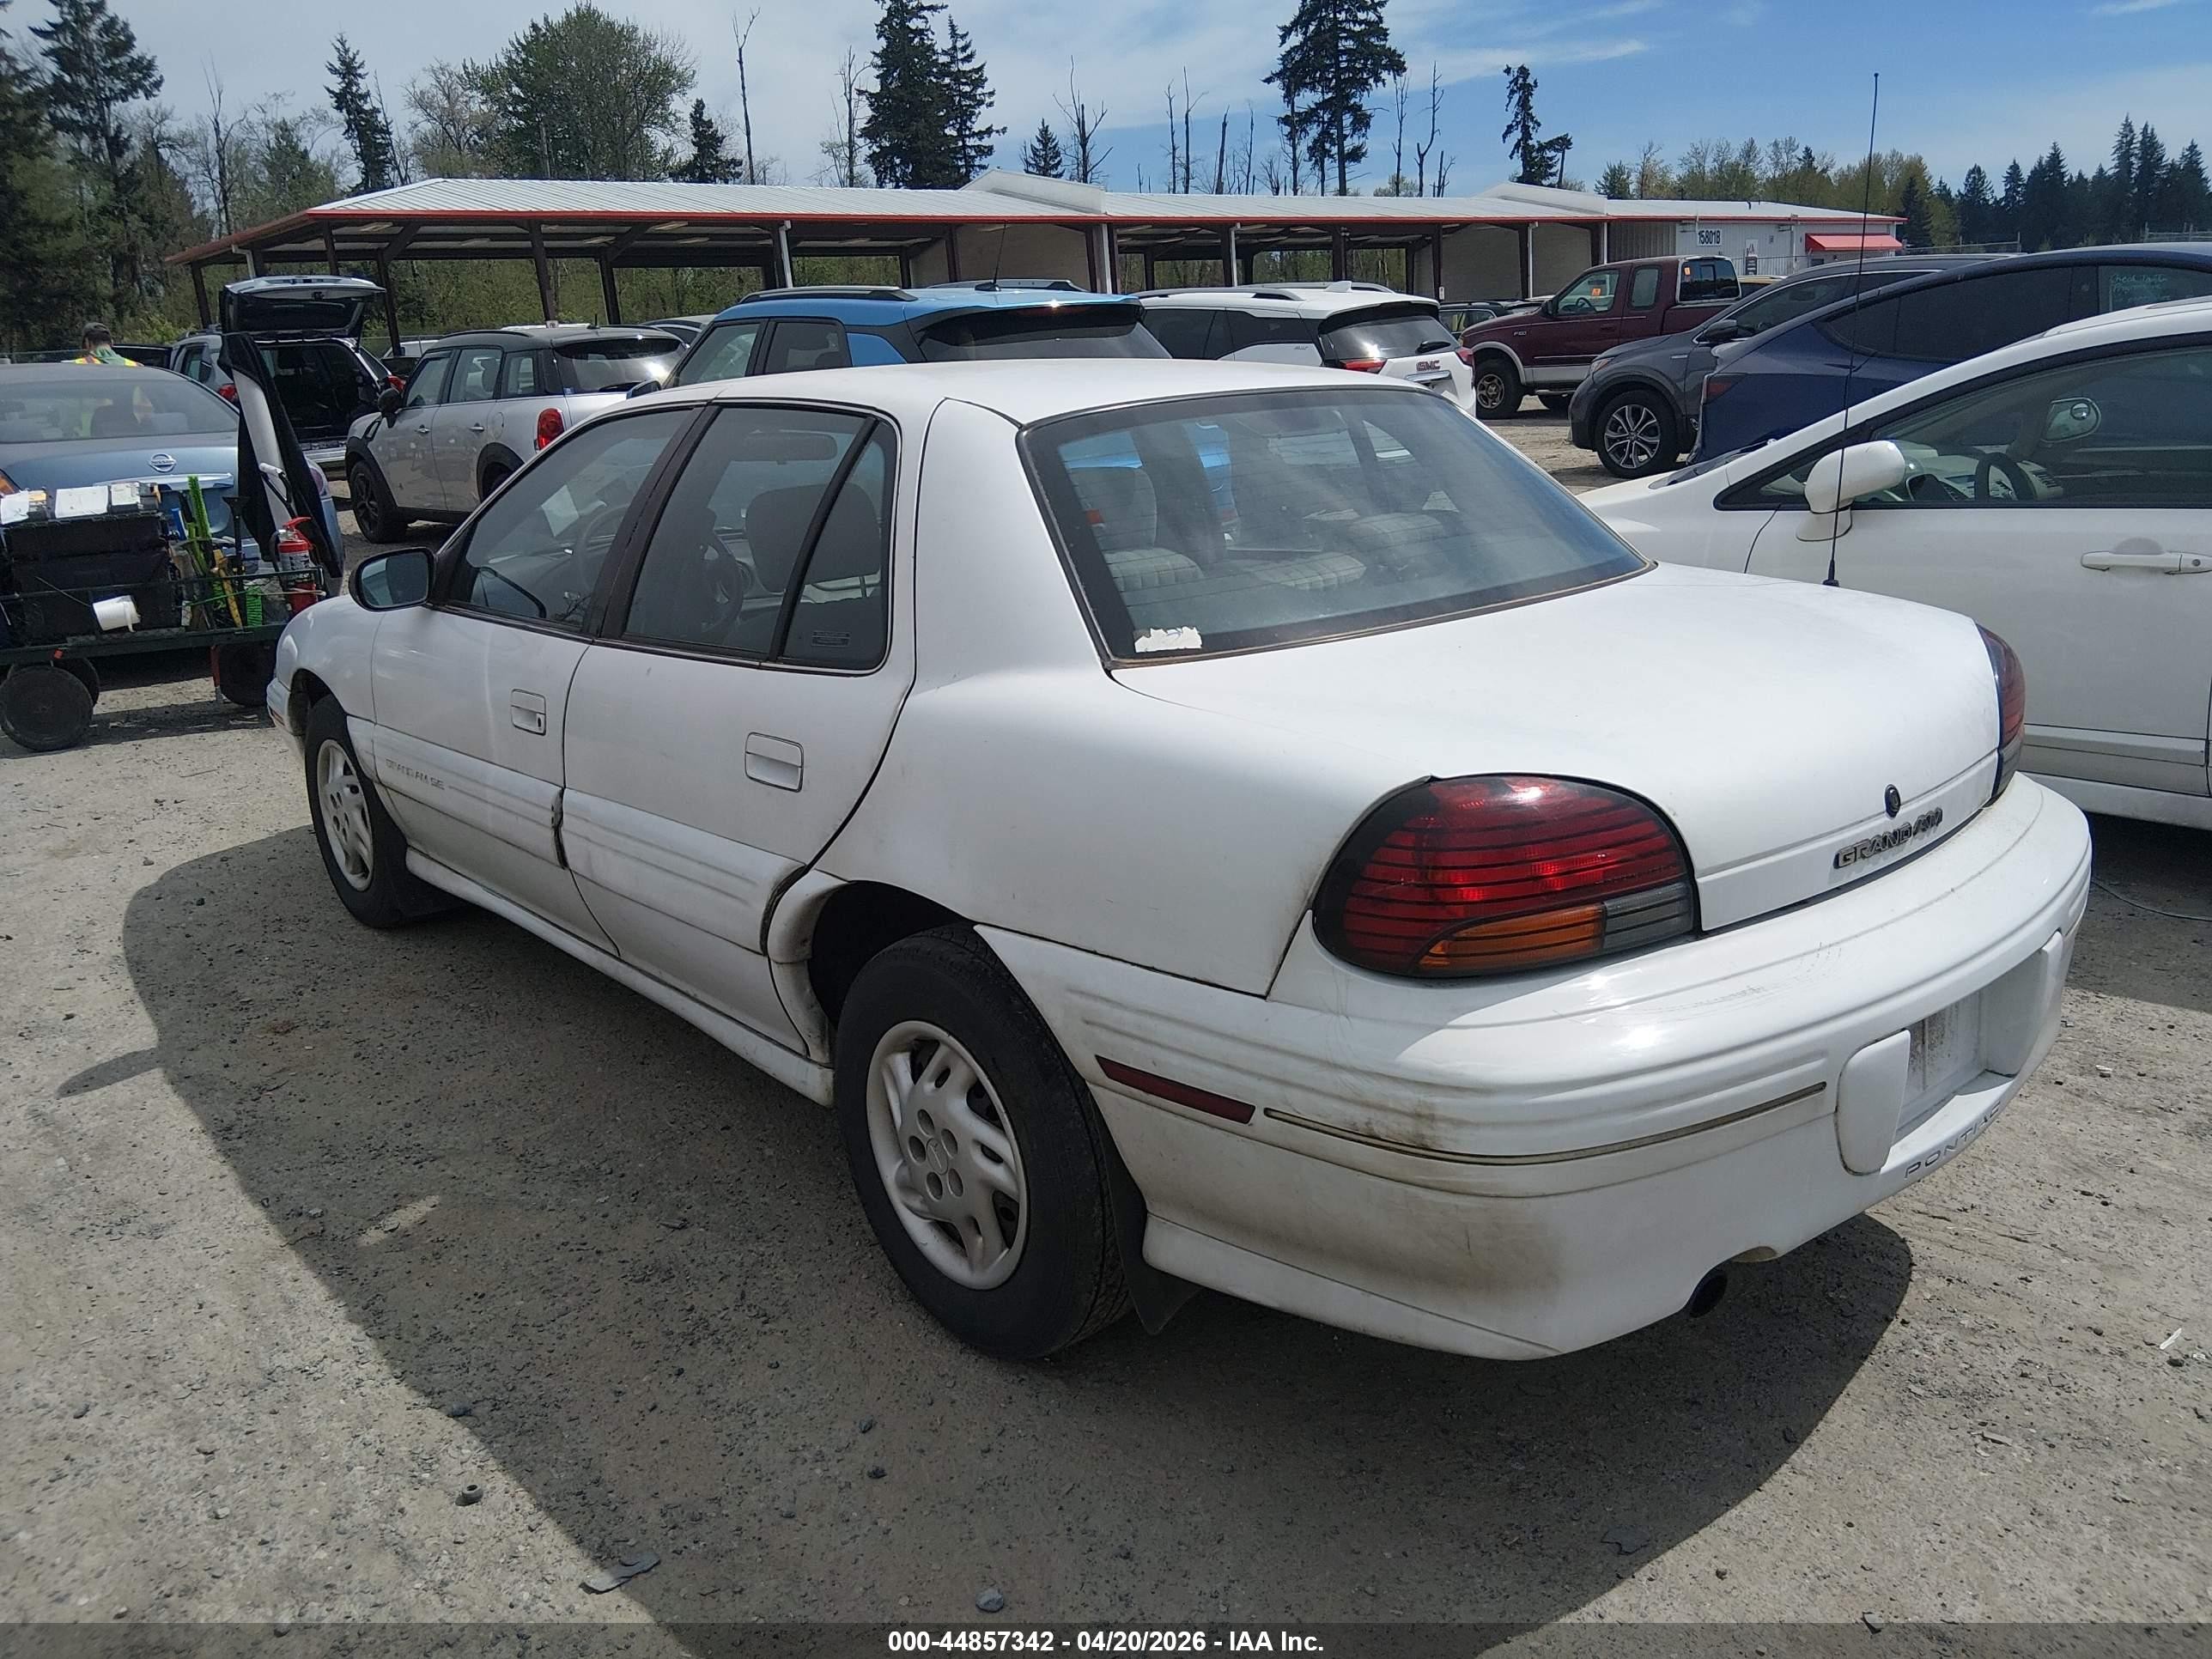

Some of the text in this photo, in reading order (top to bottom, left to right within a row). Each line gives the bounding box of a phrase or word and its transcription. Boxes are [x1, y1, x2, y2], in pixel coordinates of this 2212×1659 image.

[1416, 360, 1441, 371] GMC
[1833, 807, 1943, 869] GRAND AM
[1904, 1100, 2001, 1179] PONTIAC
